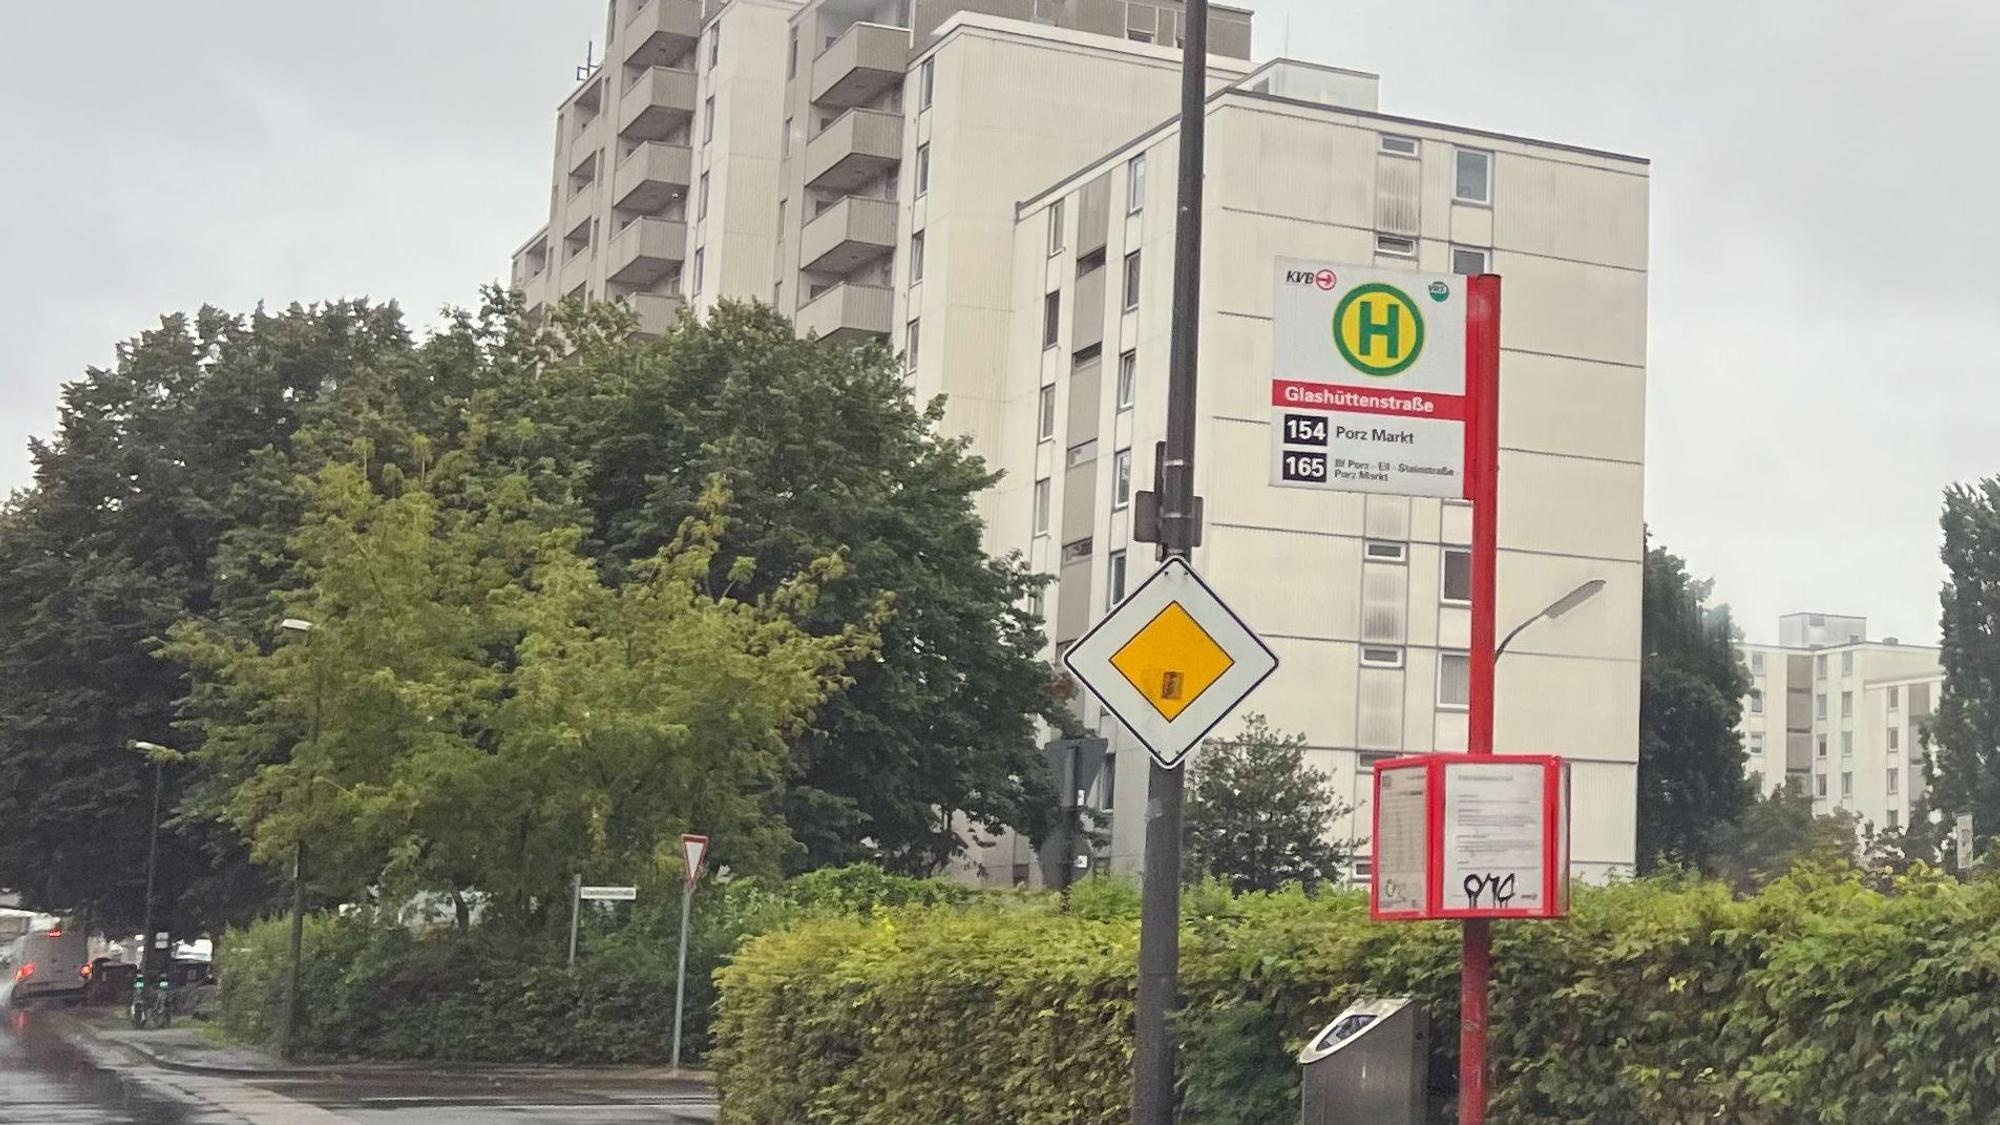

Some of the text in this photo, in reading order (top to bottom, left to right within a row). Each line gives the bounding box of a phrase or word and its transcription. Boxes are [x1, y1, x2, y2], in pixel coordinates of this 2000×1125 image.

[1286, 270, 1314, 285] KVB
[1359, 302, 1399, 358] H
[1285, 387, 1434, 412] Glashüttenstraße
[1287, 420, 1414, 444] 154 Porz Markt
[1286, 456, 1324, 478] 165
[1335, 470, 1388, 481] Porz Markt
[1348, 460, 1369, 469] Porz
